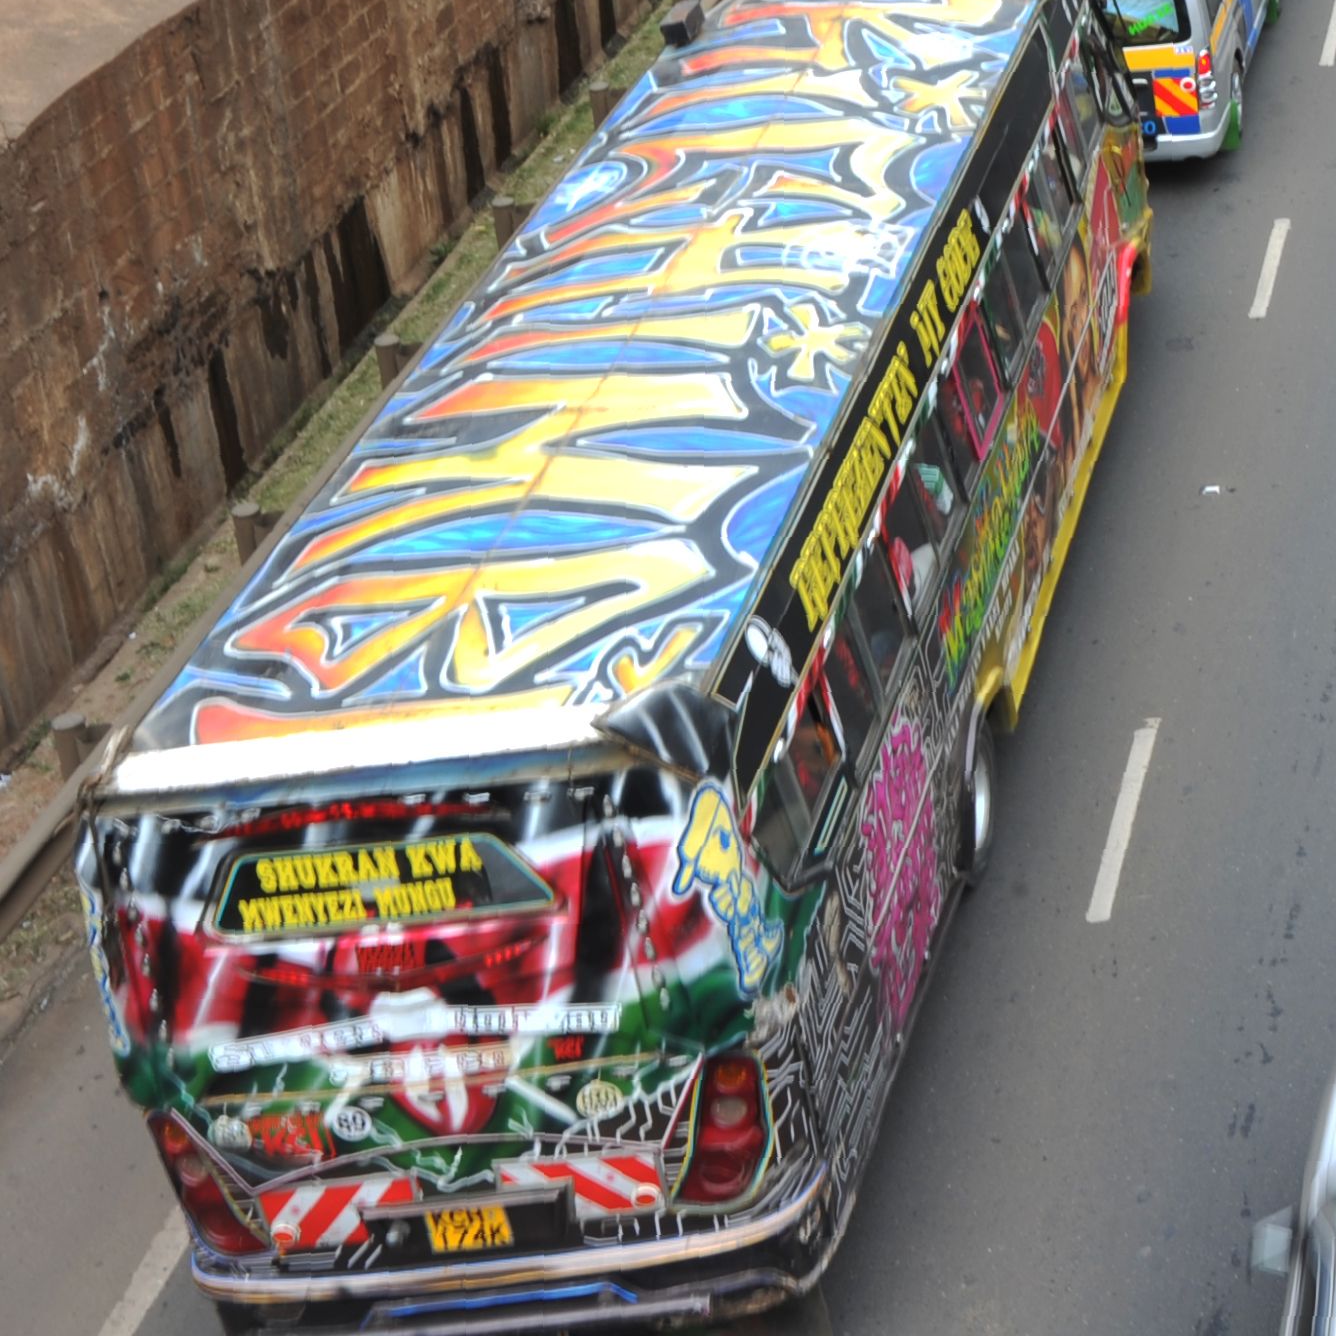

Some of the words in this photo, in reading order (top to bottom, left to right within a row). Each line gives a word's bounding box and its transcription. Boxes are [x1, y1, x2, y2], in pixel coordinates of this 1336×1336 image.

[256, 844, 400, 893] SHUKRAN
[405, 837, 483, 879] KWA
[238, 889, 368, 932] MWENYEZI
[373, 877, 457, 918] MUNGU
